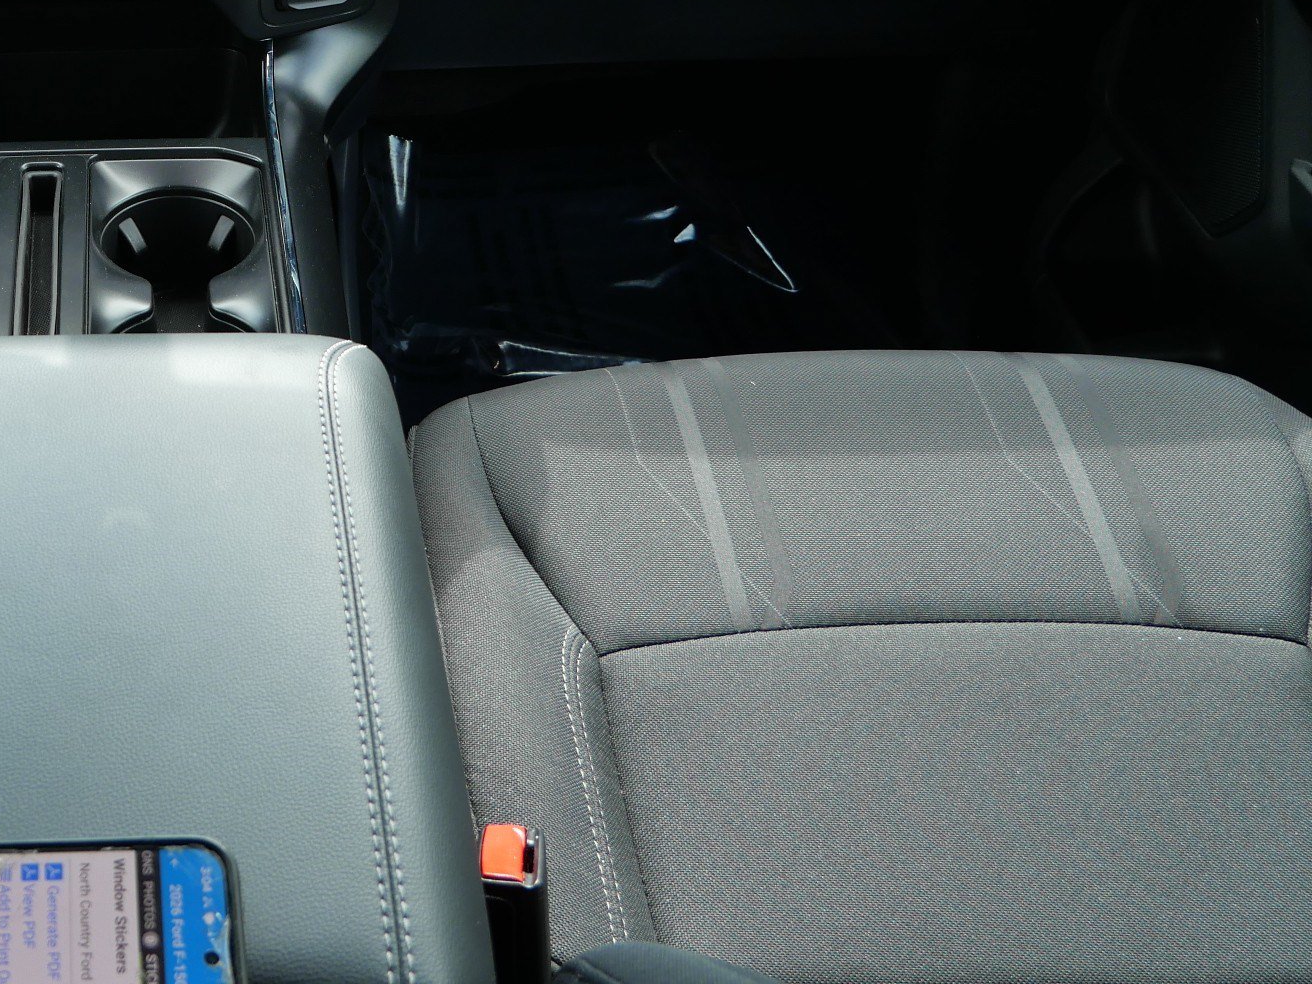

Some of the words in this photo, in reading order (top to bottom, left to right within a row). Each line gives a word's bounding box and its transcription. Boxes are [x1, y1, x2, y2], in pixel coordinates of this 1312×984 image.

[80, 862, 91, 897] North
[113, 858, 127, 912] Window
[200, 867, 212, 892] 3:04
[22, 884, 35, 916] View
[143, 881, 156, 930] PHOTOS
[169, 884, 183, 915] 2026
[47, 885, 61, 948] Generate
[78, 900, 92, 948] Country
[23, 921, 36, 948] PDF
[115, 916, 128, 974] Stickers
[172, 918, 186, 948] Ford
[48, 952, 62, 981] PDF
[81, 952, 93, 981] Ford
